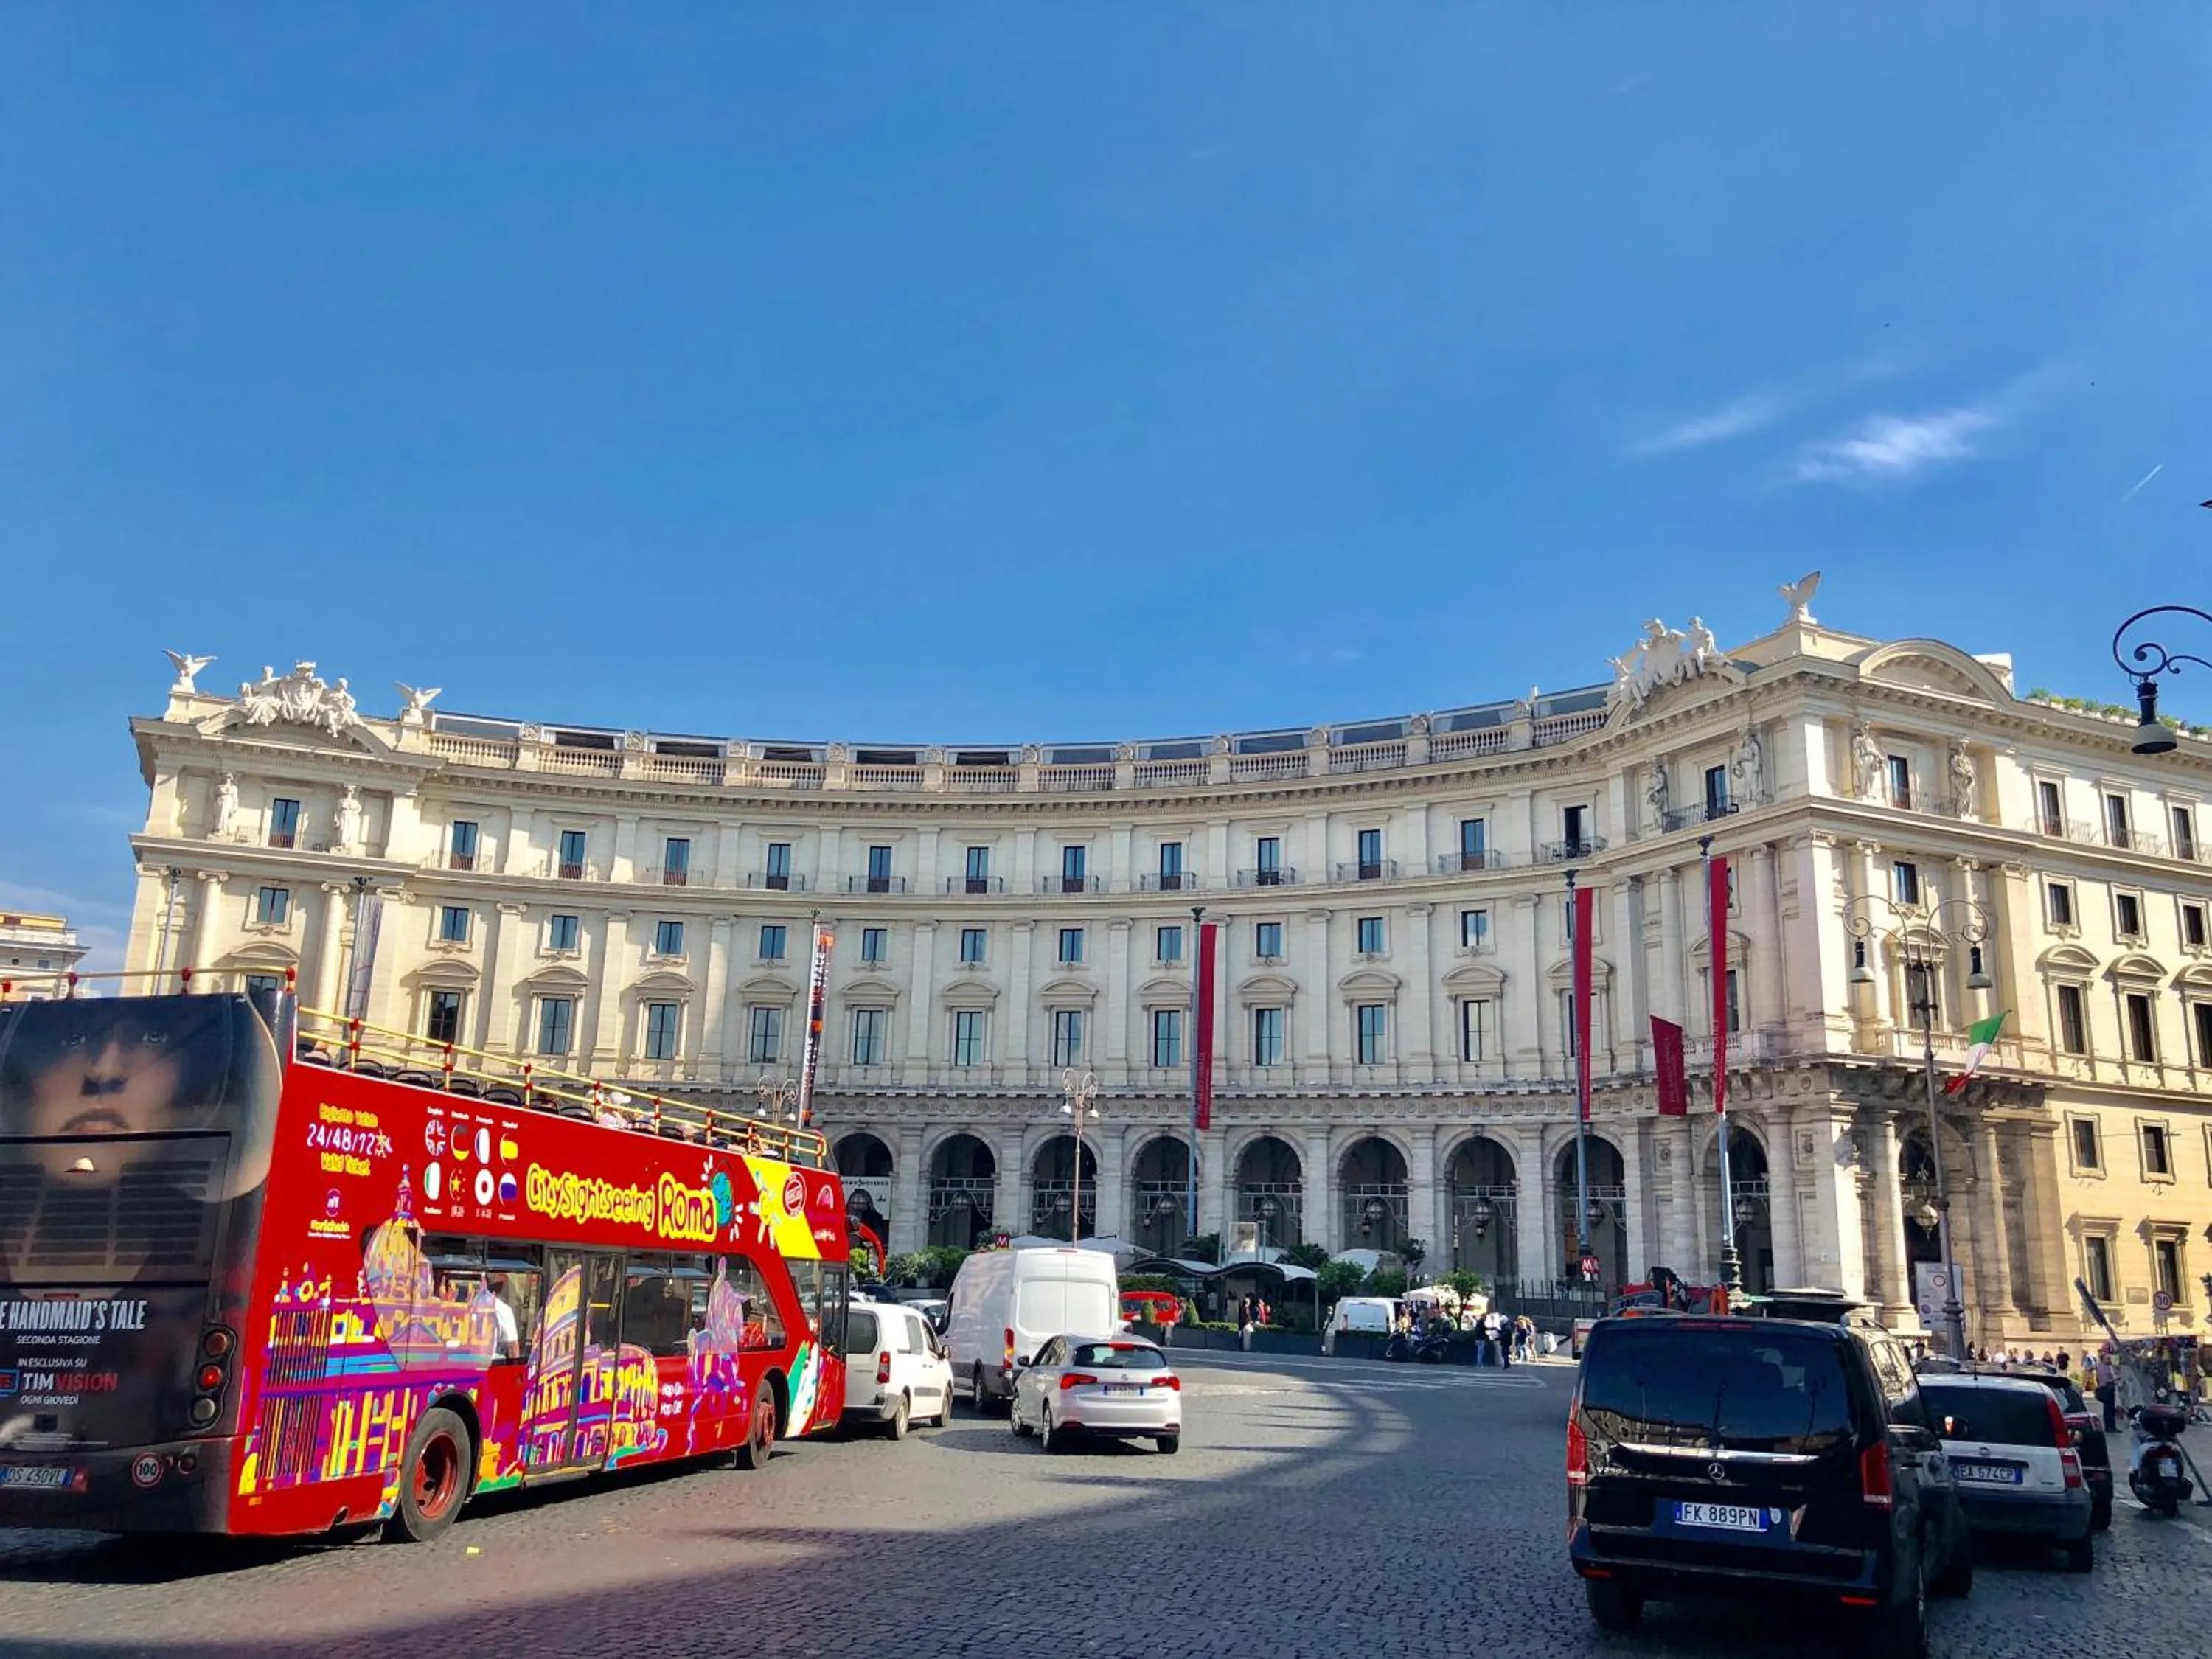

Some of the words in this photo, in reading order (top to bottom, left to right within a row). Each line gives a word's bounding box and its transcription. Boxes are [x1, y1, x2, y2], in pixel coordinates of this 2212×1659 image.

[658, 1172, 717, 1242] Roma
[2157, 1295, 2168, 1306] 30
[8, 1300, 108, 1330] HANDMAID'S
[110, 1300, 147, 1329] TALE
[16, 1335, 57, 1344] SECONDA
[58, 1335, 101, 1344] STAGIONE
[75, 1357, 88, 1368] SU
[139, 1462, 157, 1475] 100
[1684, 1503, 1702, 1520] FK
[1708, 1506, 1757, 1527] 889PN
